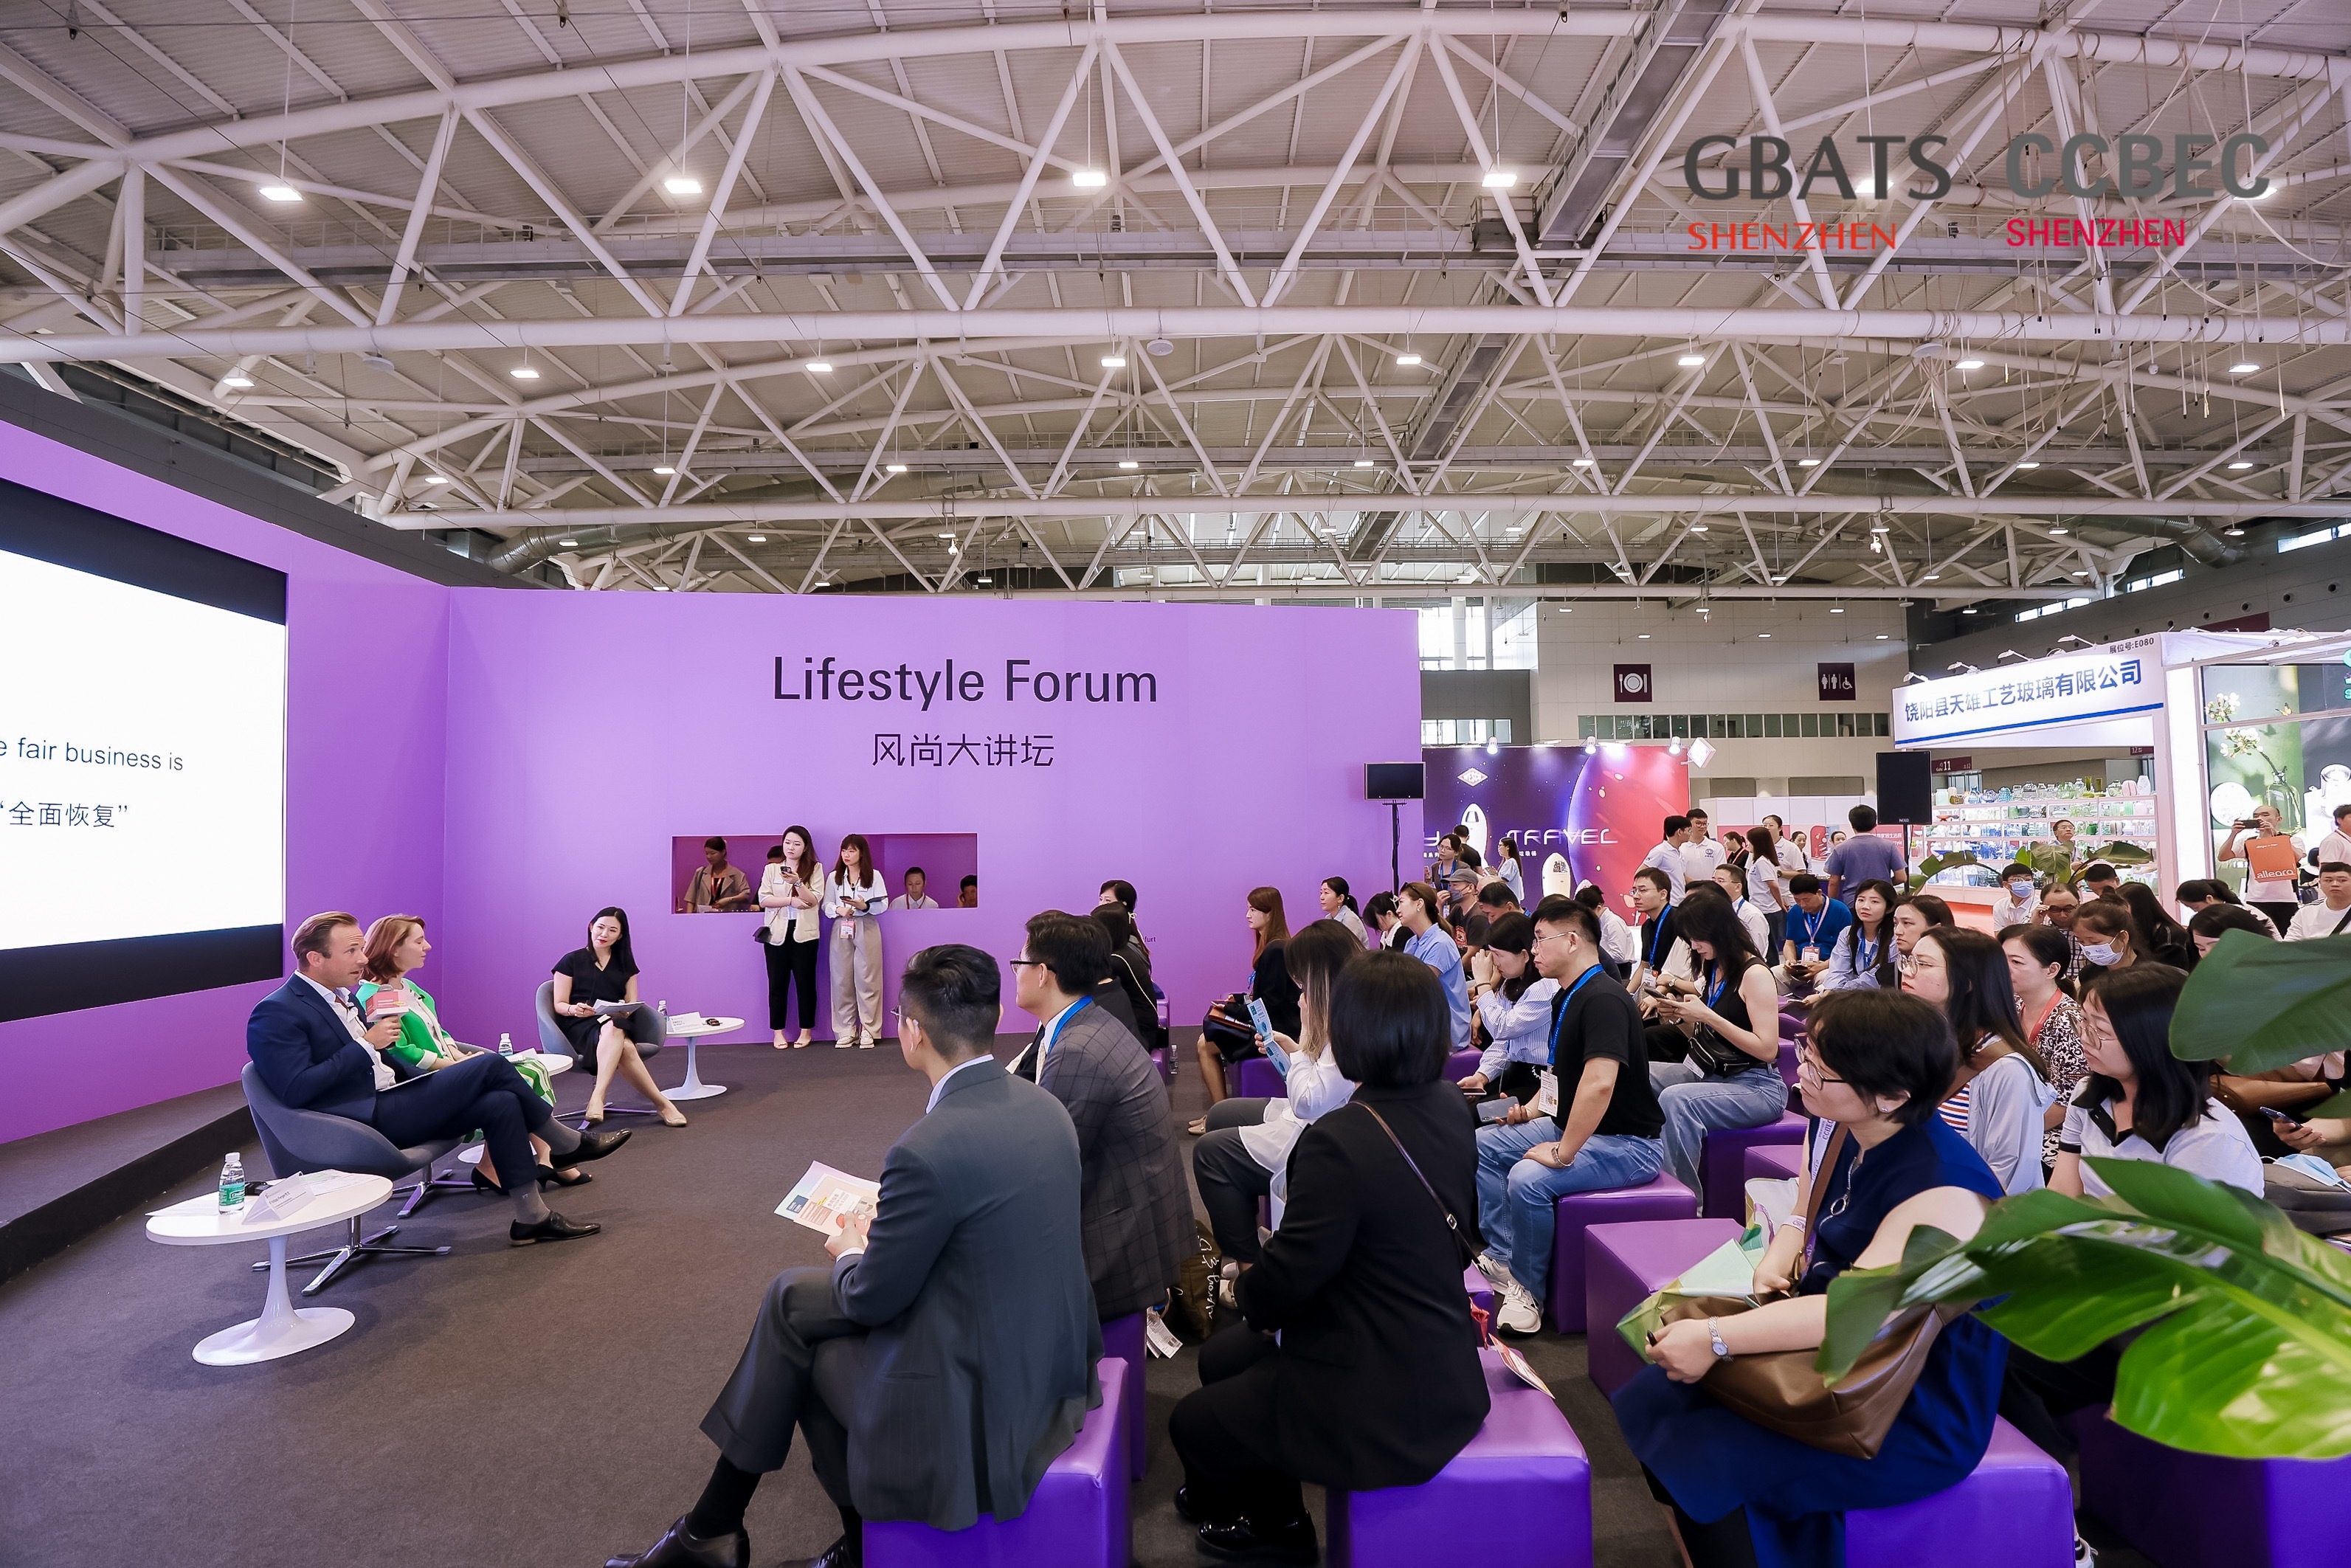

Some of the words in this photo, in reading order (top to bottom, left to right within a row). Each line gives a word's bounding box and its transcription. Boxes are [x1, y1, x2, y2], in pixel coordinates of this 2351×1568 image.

[773, 656, 984, 711] Lifestyle
[1005, 659, 1157, 702] Forum
[1905, 659, 2141, 722] 饶阳县天雄工艺玻璃有限公司
[18, 737, 57, 759] fair
[66, 742, 162, 769] business
[169, 752, 183, 770] is
[871, 733, 1054, 767] 风尚大讲坛
[1944, 761, 1950, 771] 11
[1505, 829, 1618, 846] TRAVEL
